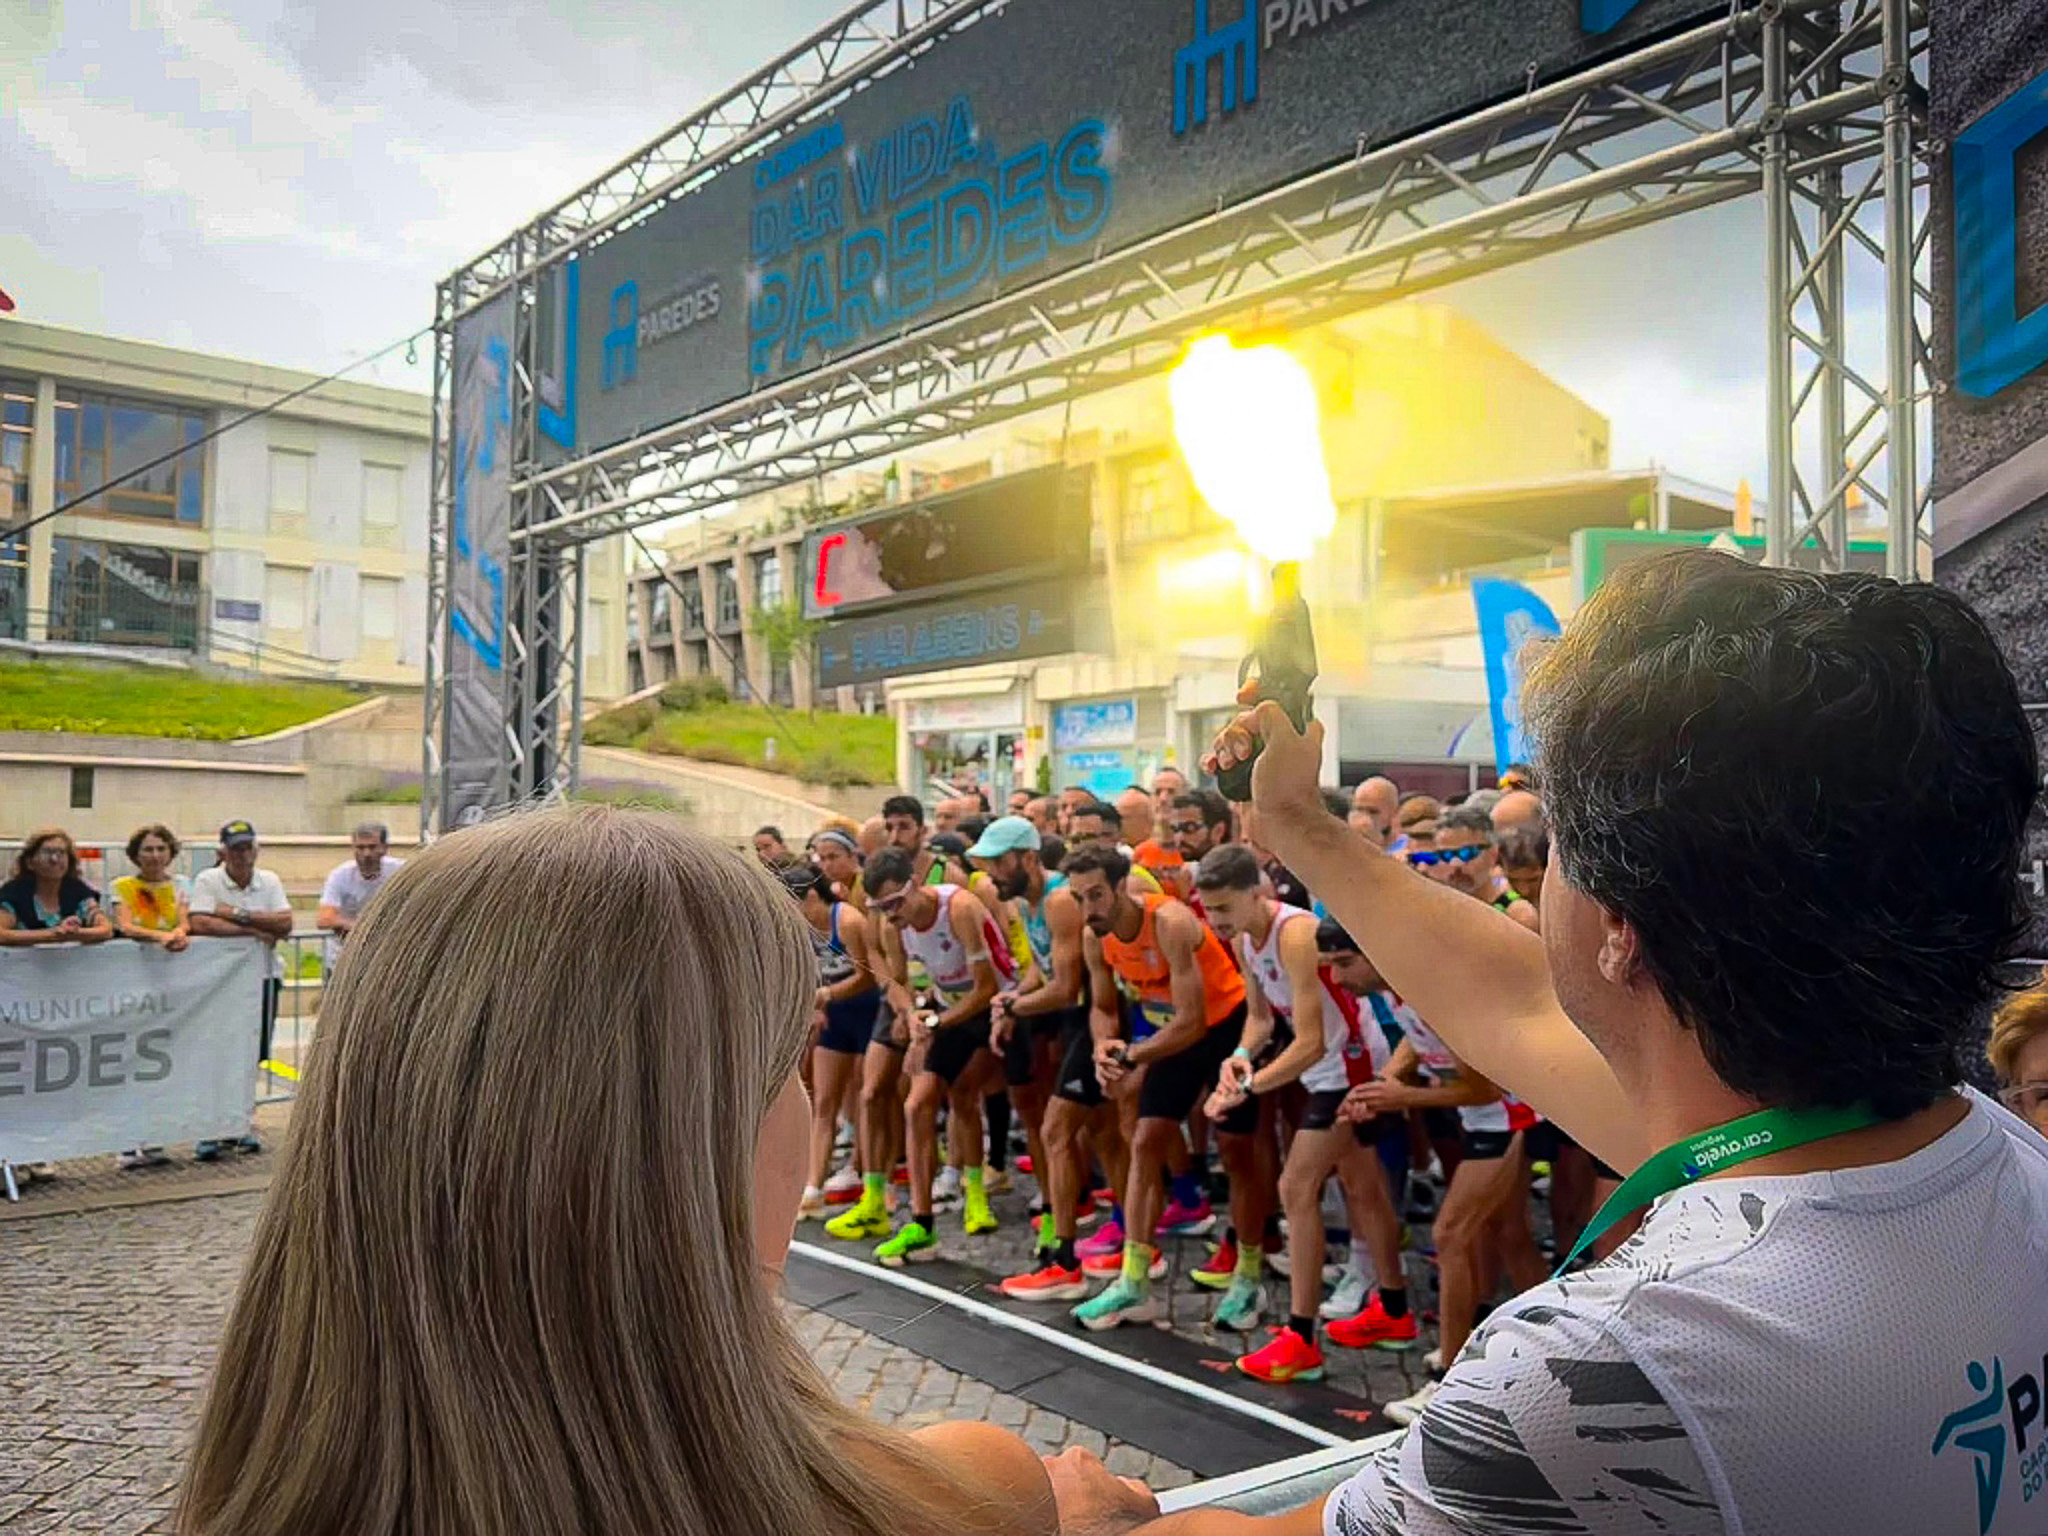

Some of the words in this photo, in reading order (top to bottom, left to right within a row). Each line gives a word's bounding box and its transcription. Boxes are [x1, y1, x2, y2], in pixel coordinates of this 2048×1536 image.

[1263, 0, 1369, 49] PAR
[752, 166, 844, 264] DAR
[851, 95, 977, 216] VIDA
[751, 119, 1112, 375] PAREDES
[637, 282, 721, 348] PAREDES
[0, 992, 176, 1024] MUNICIPAL
[1695, 1130, 1773, 1168] caravela
[2007, 1353, 2048, 1453] P
[2020, 1437, 2048, 1479] CAP
[2023, 1472, 2043, 1503] DO
